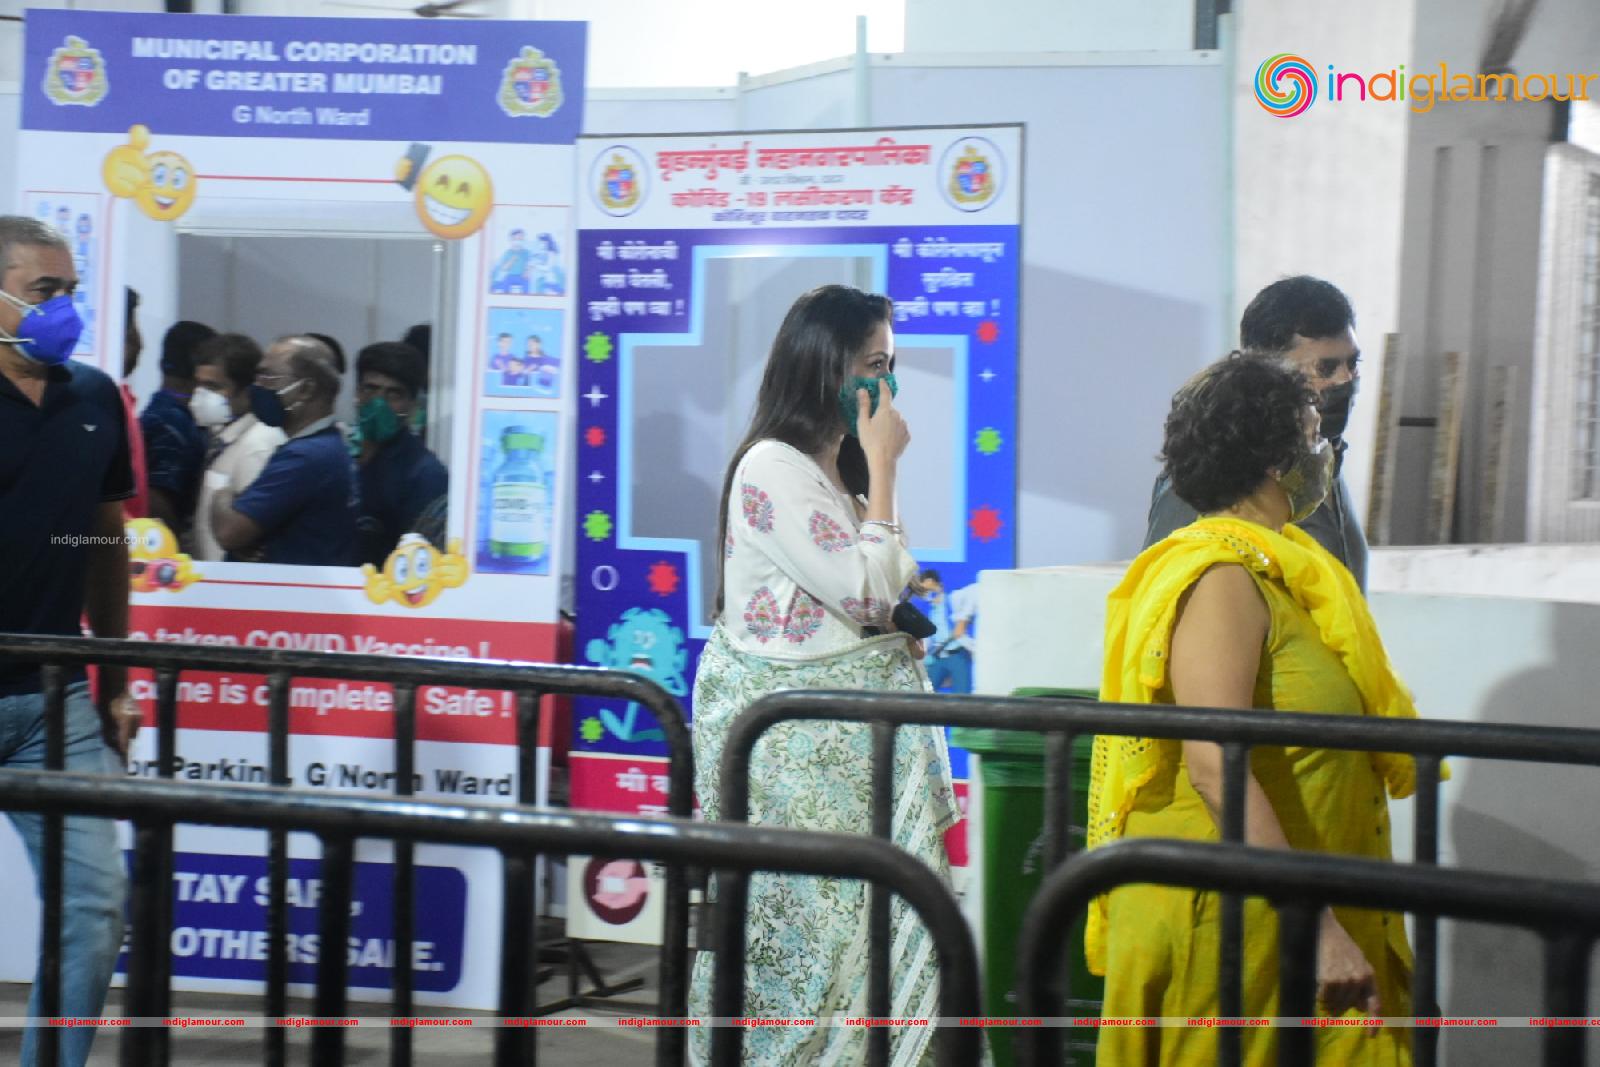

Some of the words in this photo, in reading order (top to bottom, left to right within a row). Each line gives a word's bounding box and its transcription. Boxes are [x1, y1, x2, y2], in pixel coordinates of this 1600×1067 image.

[131, 37, 280, 61] MUNICIPAL
[284, 40, 478, 65] CORPORATION
[163, 68, 201, 90] OF
[205, 69, 327, 93] GREATER
[333, 72, 443, 95] MUMBAI
[232, 105, 252, 123] G
[254, 105, 313, 125] North
[315, 107, 371, 126] Ward
[219, 678, 248, 704] is
[424, 687, 494, 717] Safe
[500, 691, 513, 718] !
[435, 769, 512, 796] Ward
